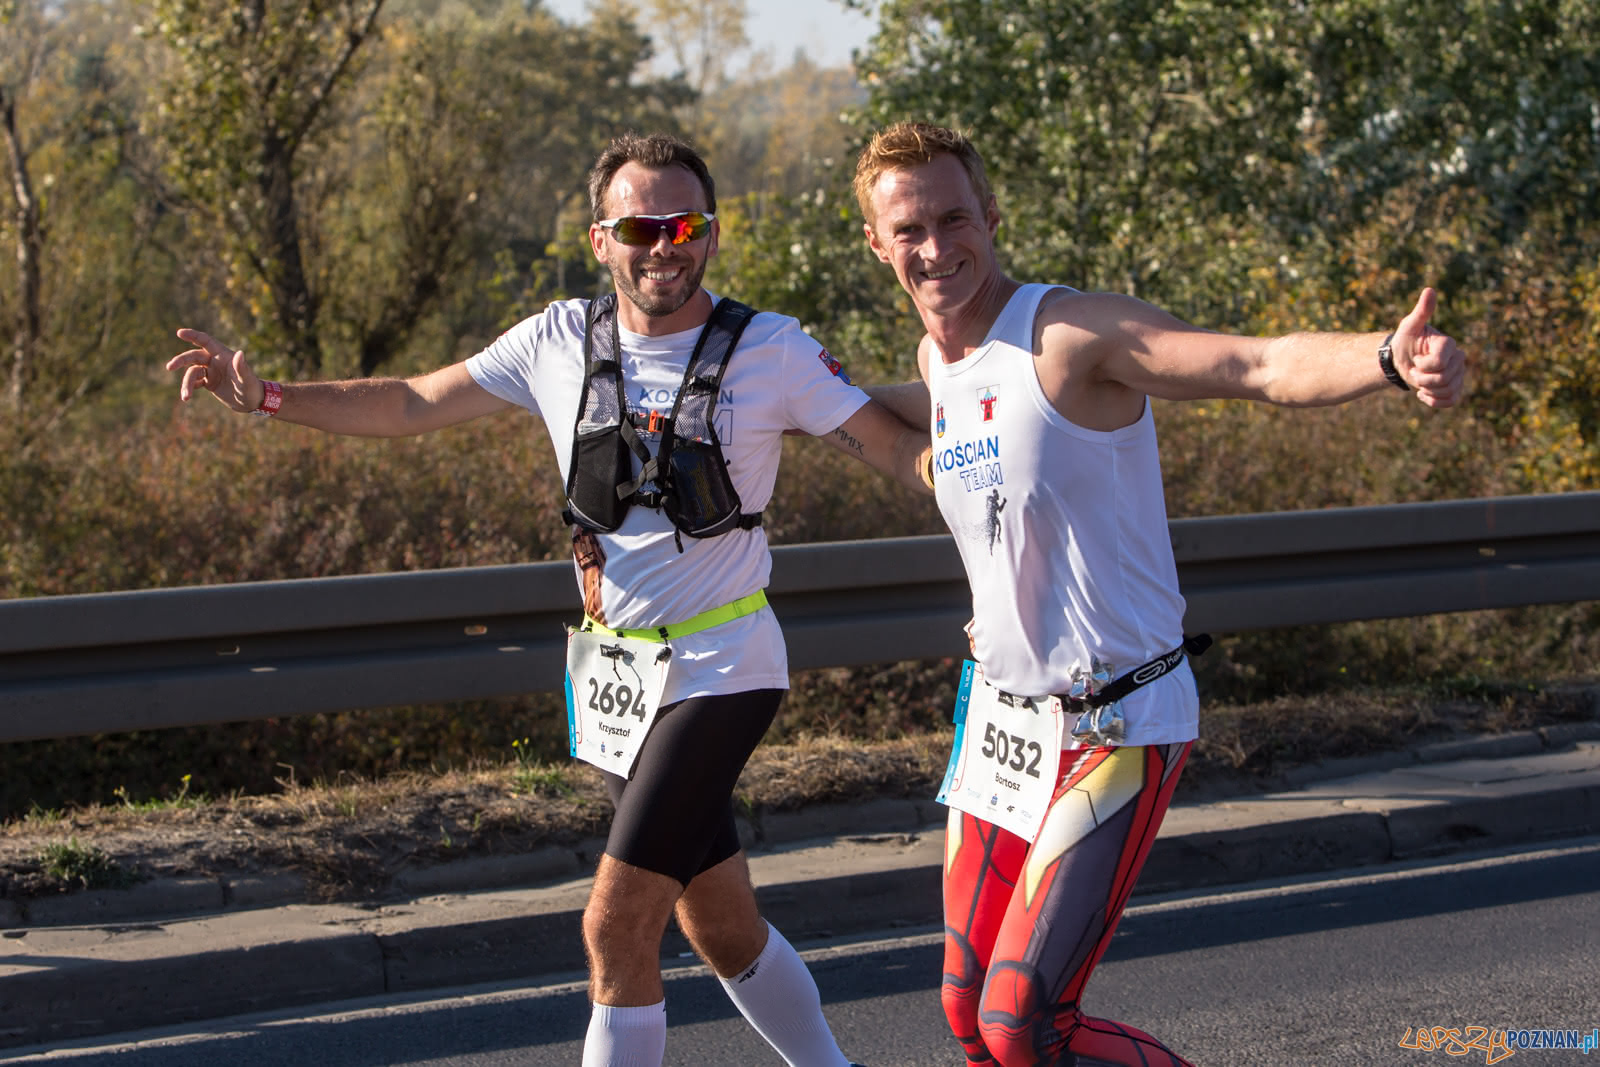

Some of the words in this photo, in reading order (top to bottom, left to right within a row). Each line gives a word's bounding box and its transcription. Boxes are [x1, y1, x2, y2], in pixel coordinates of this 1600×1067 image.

[935, 435, 999, 475] KOŚCIAN
[960, 462, 1003, 492] TEAM
[588, 677, 647, 723] 2694
[598, 721, 631, 738] Krzysztof
[981, 722, 1043, 779] 5032
[995, 772, 1021, 791] Bartosz
